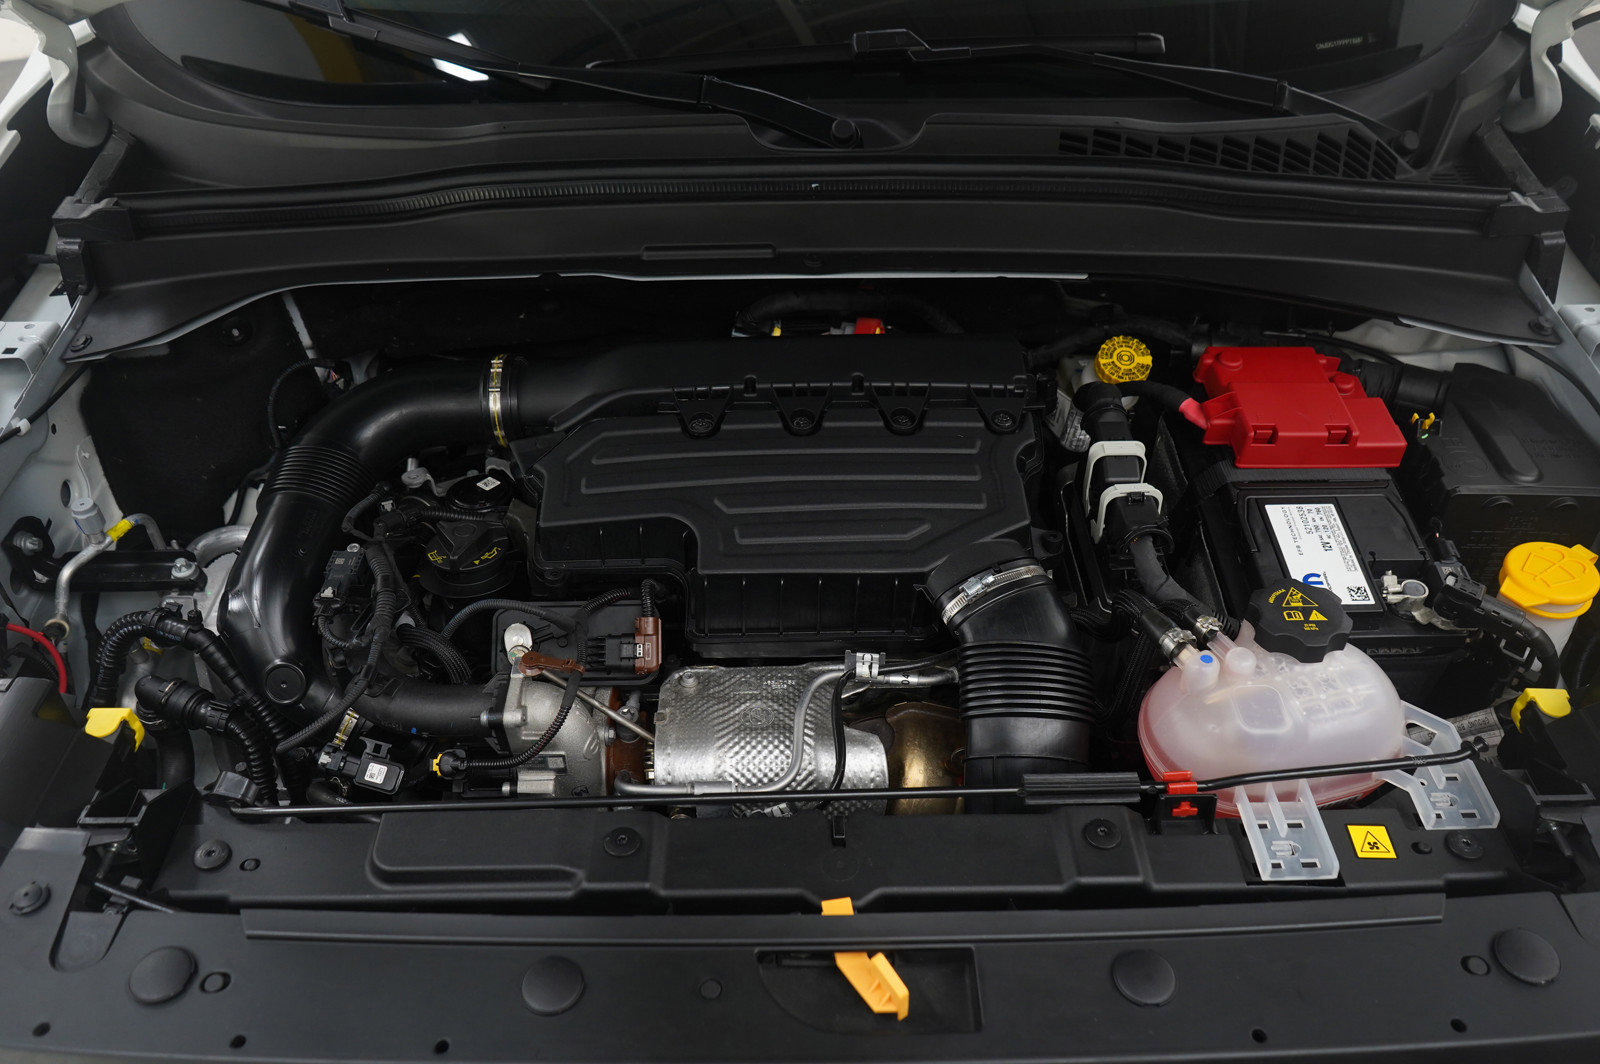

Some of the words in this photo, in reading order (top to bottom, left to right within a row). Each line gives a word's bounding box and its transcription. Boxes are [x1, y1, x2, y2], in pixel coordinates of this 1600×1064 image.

[1282, 507, 1298, 542] TECHNOLOGY
[1320, 541, 1333, 551] 12V
[1468, 716, 1490, 728] GROUND
